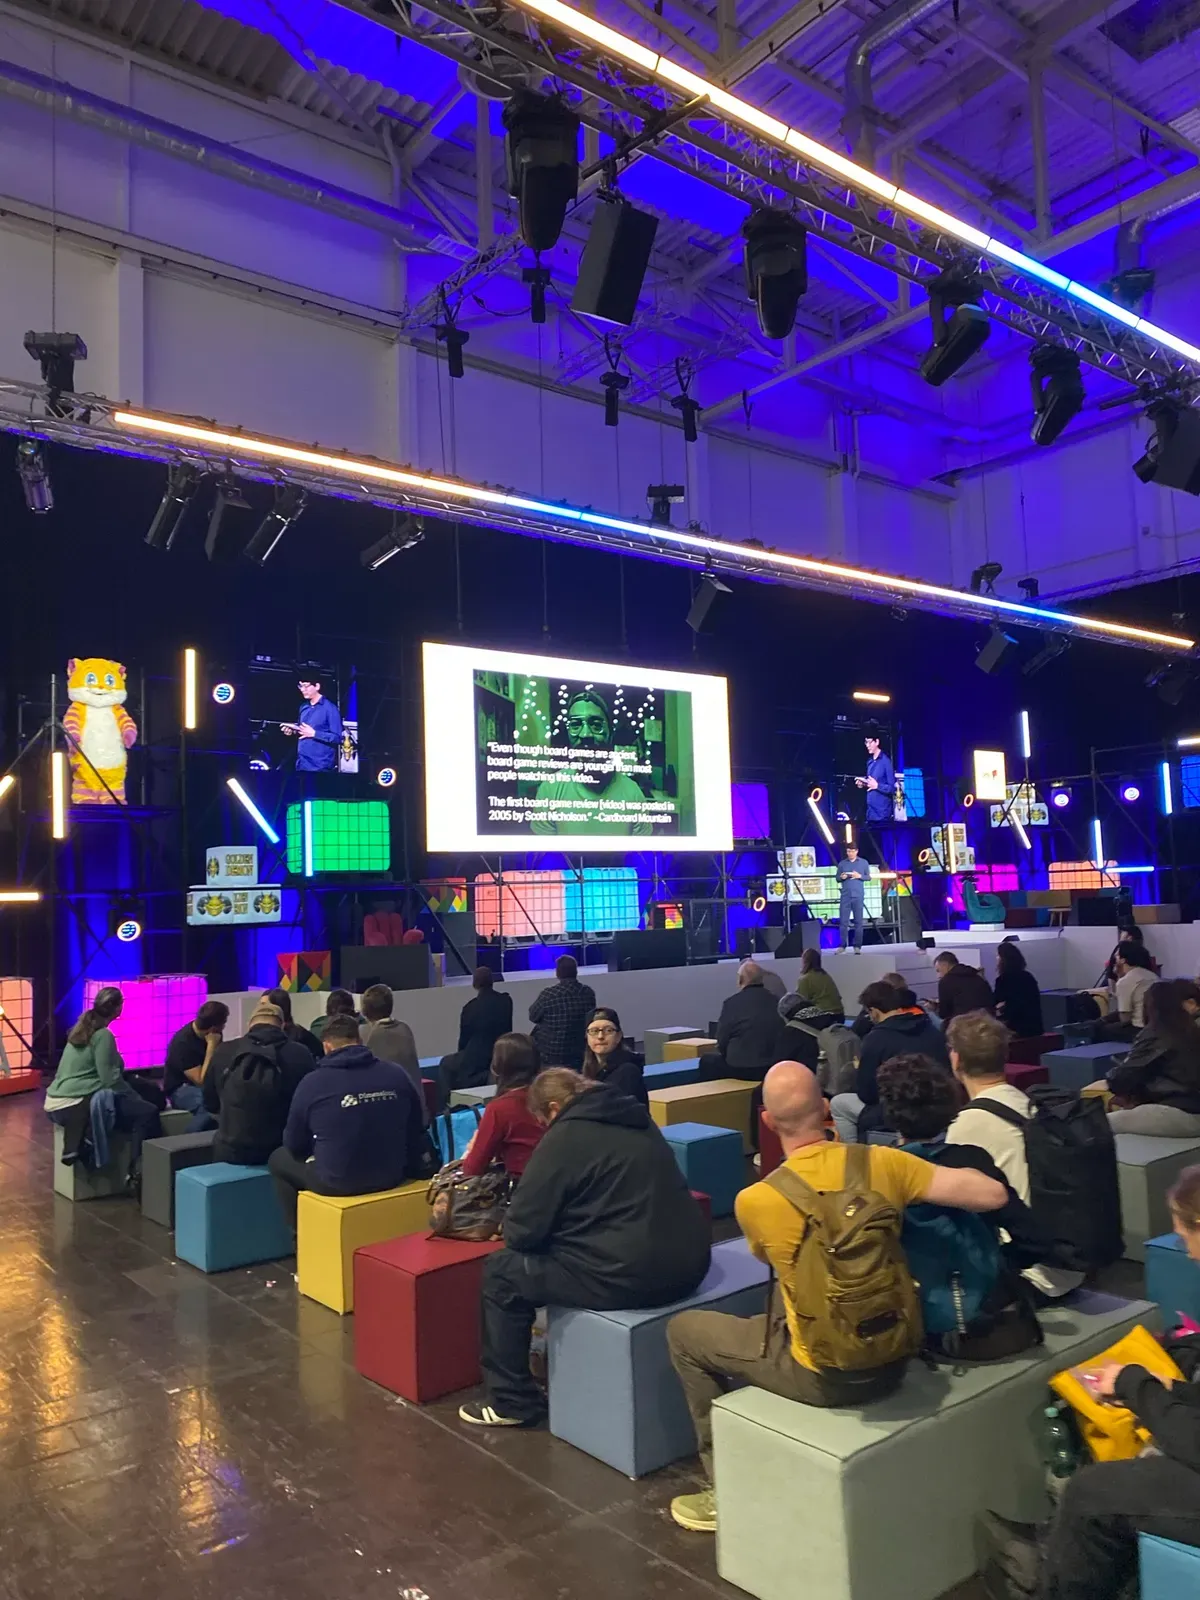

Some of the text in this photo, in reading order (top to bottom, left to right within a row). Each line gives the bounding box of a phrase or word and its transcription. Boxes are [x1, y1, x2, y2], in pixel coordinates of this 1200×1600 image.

[514, 743, 543, 757] though
[544, 746, 567, 756] board
[568, 748, 594, 759] games
[595, 751, 608, 759] are
[487, 755, 652, 773] board game reviews are younger than most
[487, 770, 517, 781] people
[518, 772, 556, 784] watching
[556, 772, 571, 782] this
[488, 796, 506, 807] The
[506, 797, 524, 807] first
[524, 797, 548, 808] board
[549, 800, 572, 810] game
[573, 799, 599, 808] review
[626, 802, 641, 810] was
[641, 801, 667, 812] posted
[667, 801, 675, 810] in
[488, 810, 512, 821] 2005
[512, 811, 524, 823] by
[525, 811, 547, 821] Scott
[638, 813, 672, 823] Mountain
